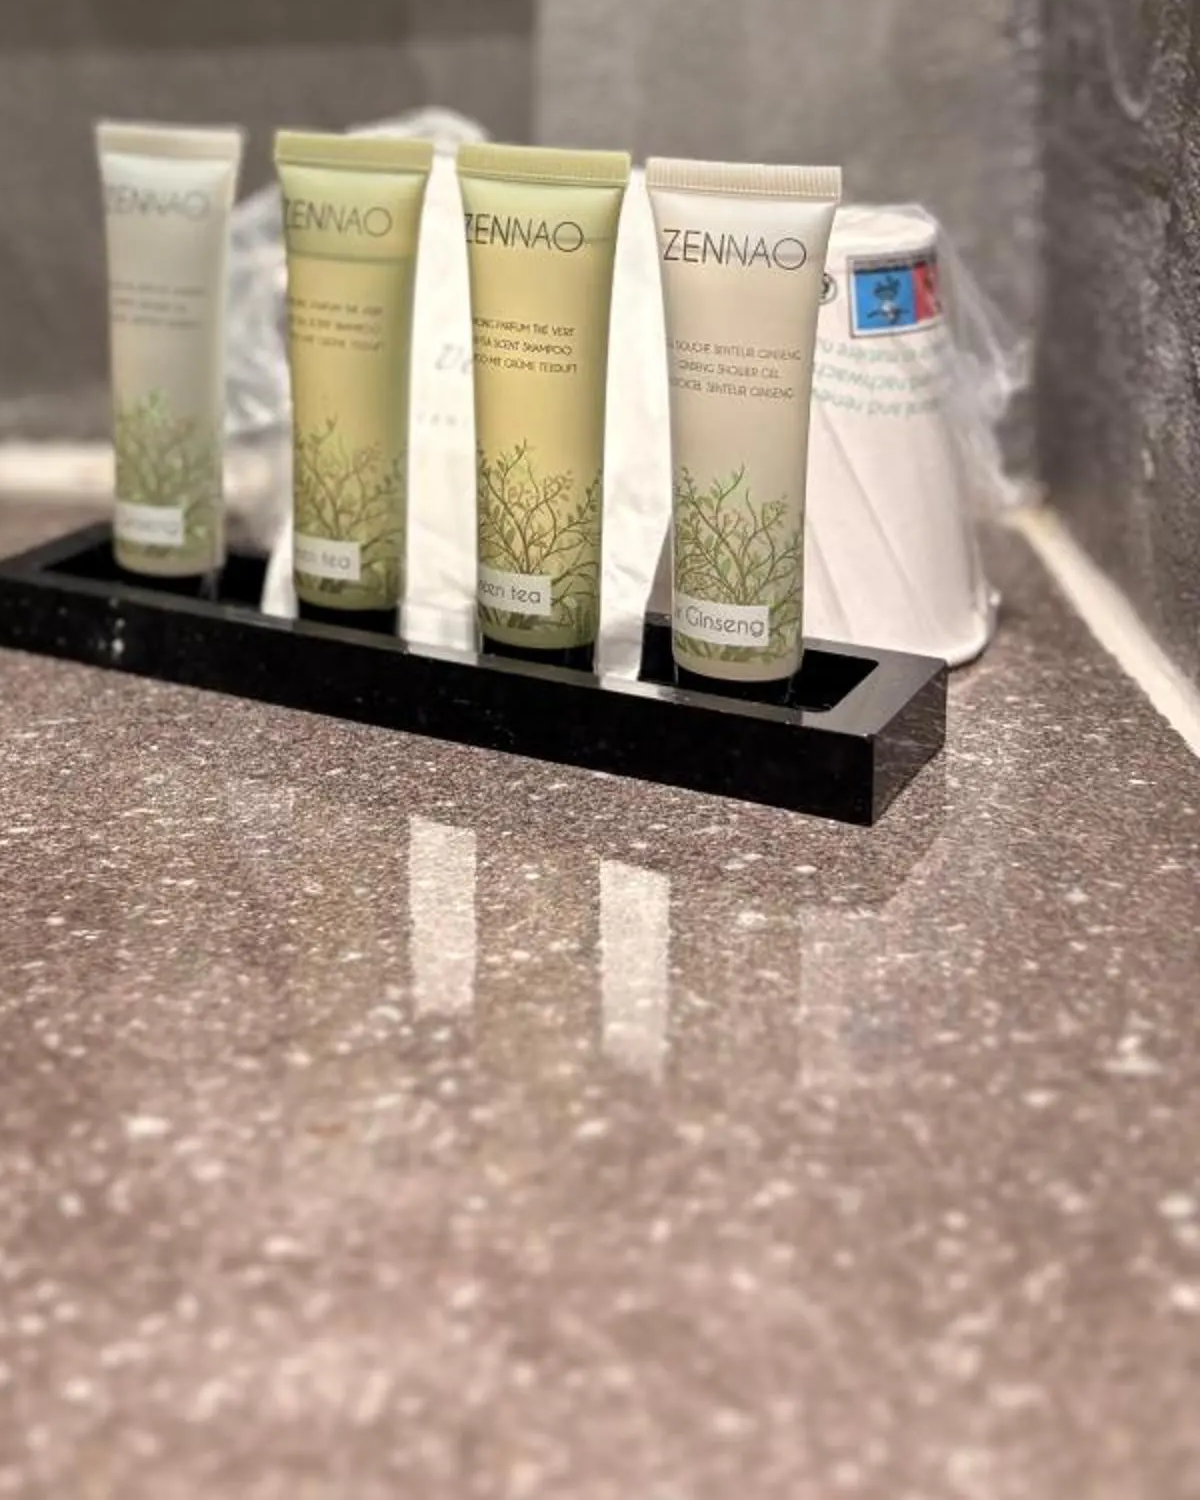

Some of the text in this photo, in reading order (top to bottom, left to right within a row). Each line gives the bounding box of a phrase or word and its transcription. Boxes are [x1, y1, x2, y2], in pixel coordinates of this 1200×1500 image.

[464, 213, 585, 252] ZENNAO
[663, 228, 807, 270] ZENNAO
[511, 586, 541, 604] tea
[685, 605, 765, 638] Ginseng
